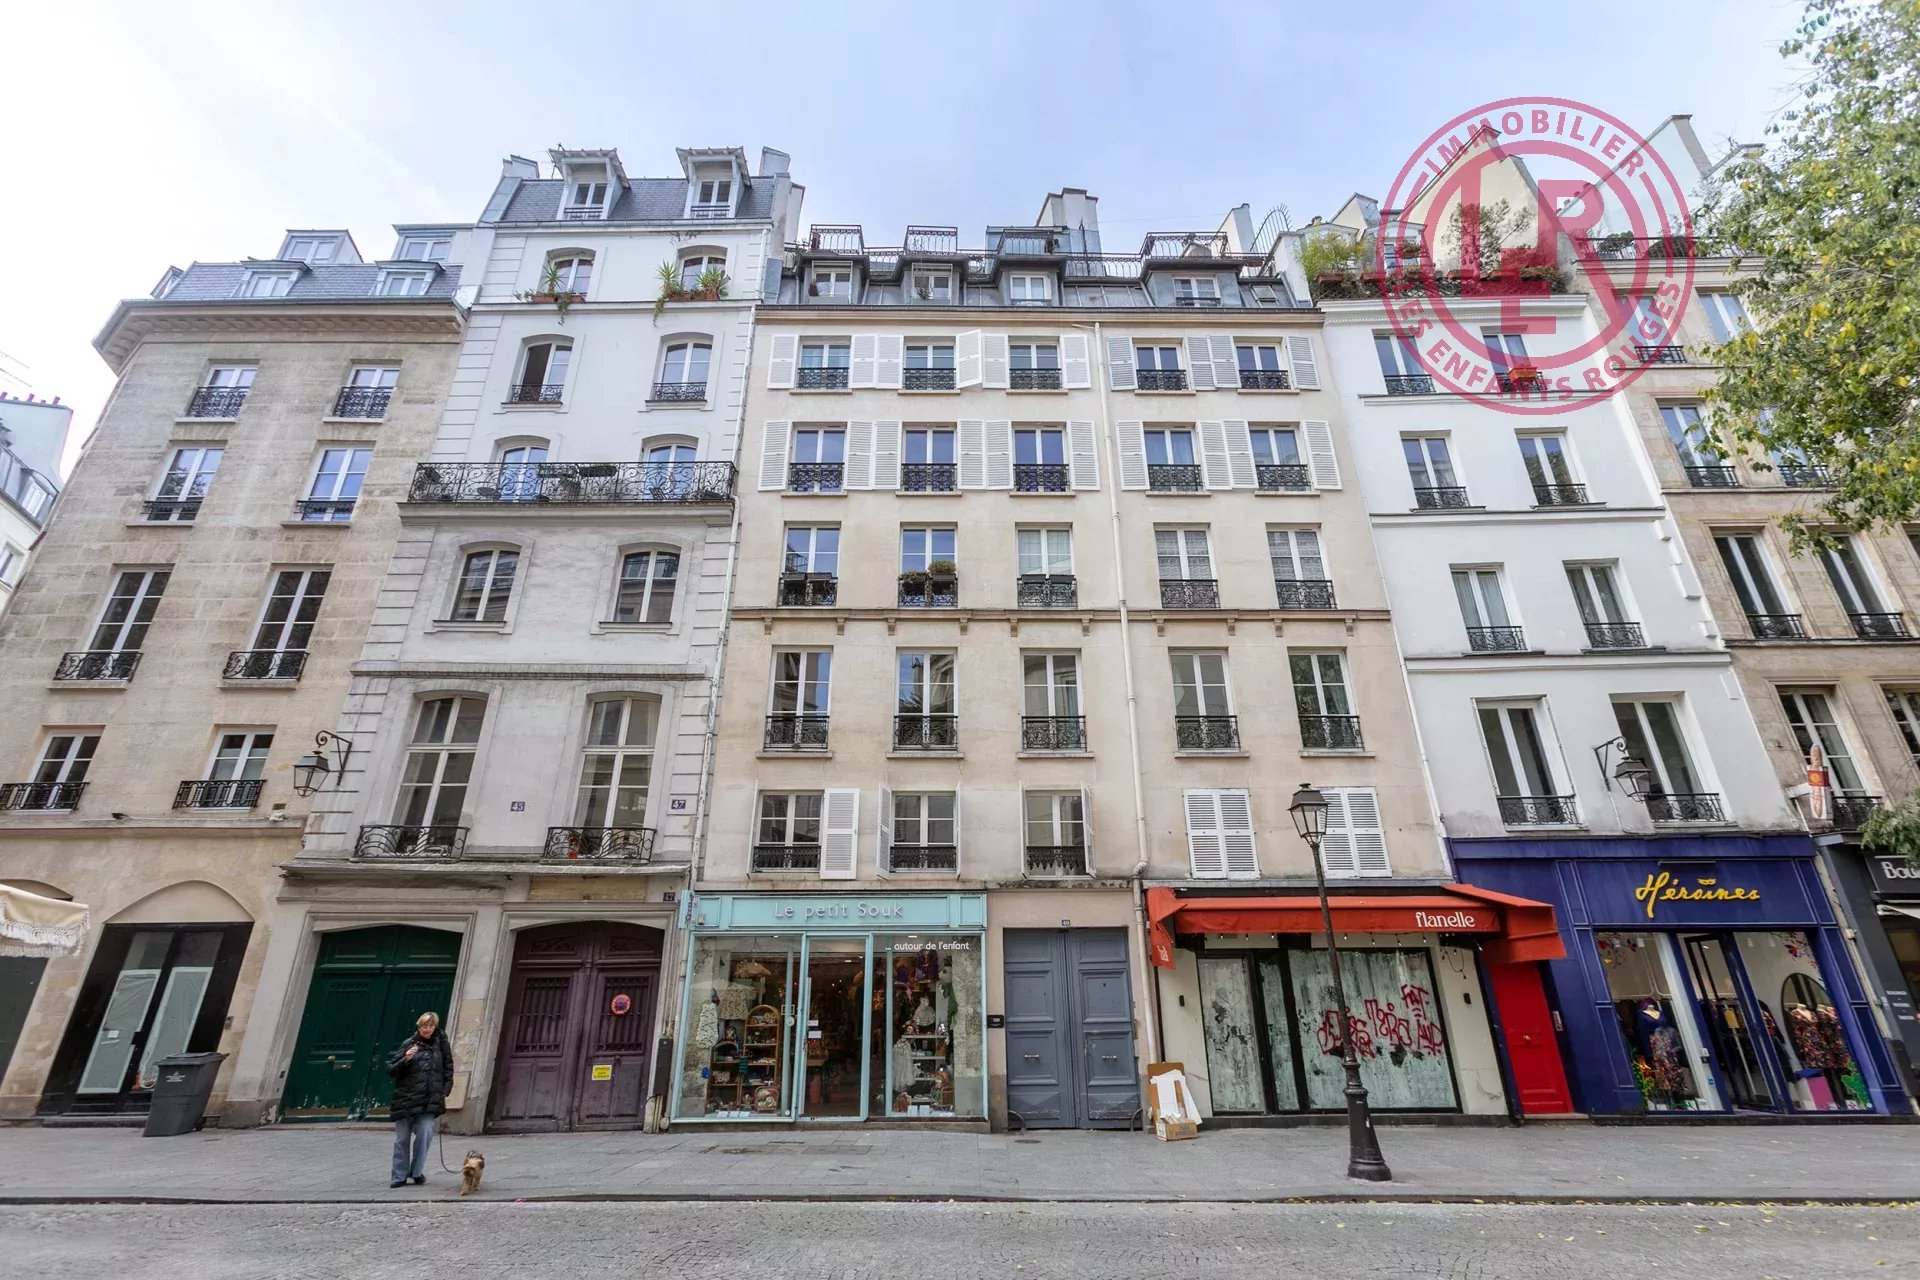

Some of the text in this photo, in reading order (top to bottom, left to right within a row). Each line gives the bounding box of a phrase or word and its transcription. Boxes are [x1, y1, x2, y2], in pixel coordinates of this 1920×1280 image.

[673, 800, 685, 809] 47
[774, 901, 903, 921] Le petit Souk
[1415, 911, 1476, 928] flanelle
[894, 942, 923, 950] autour
[925, 941, 937, 950] de
